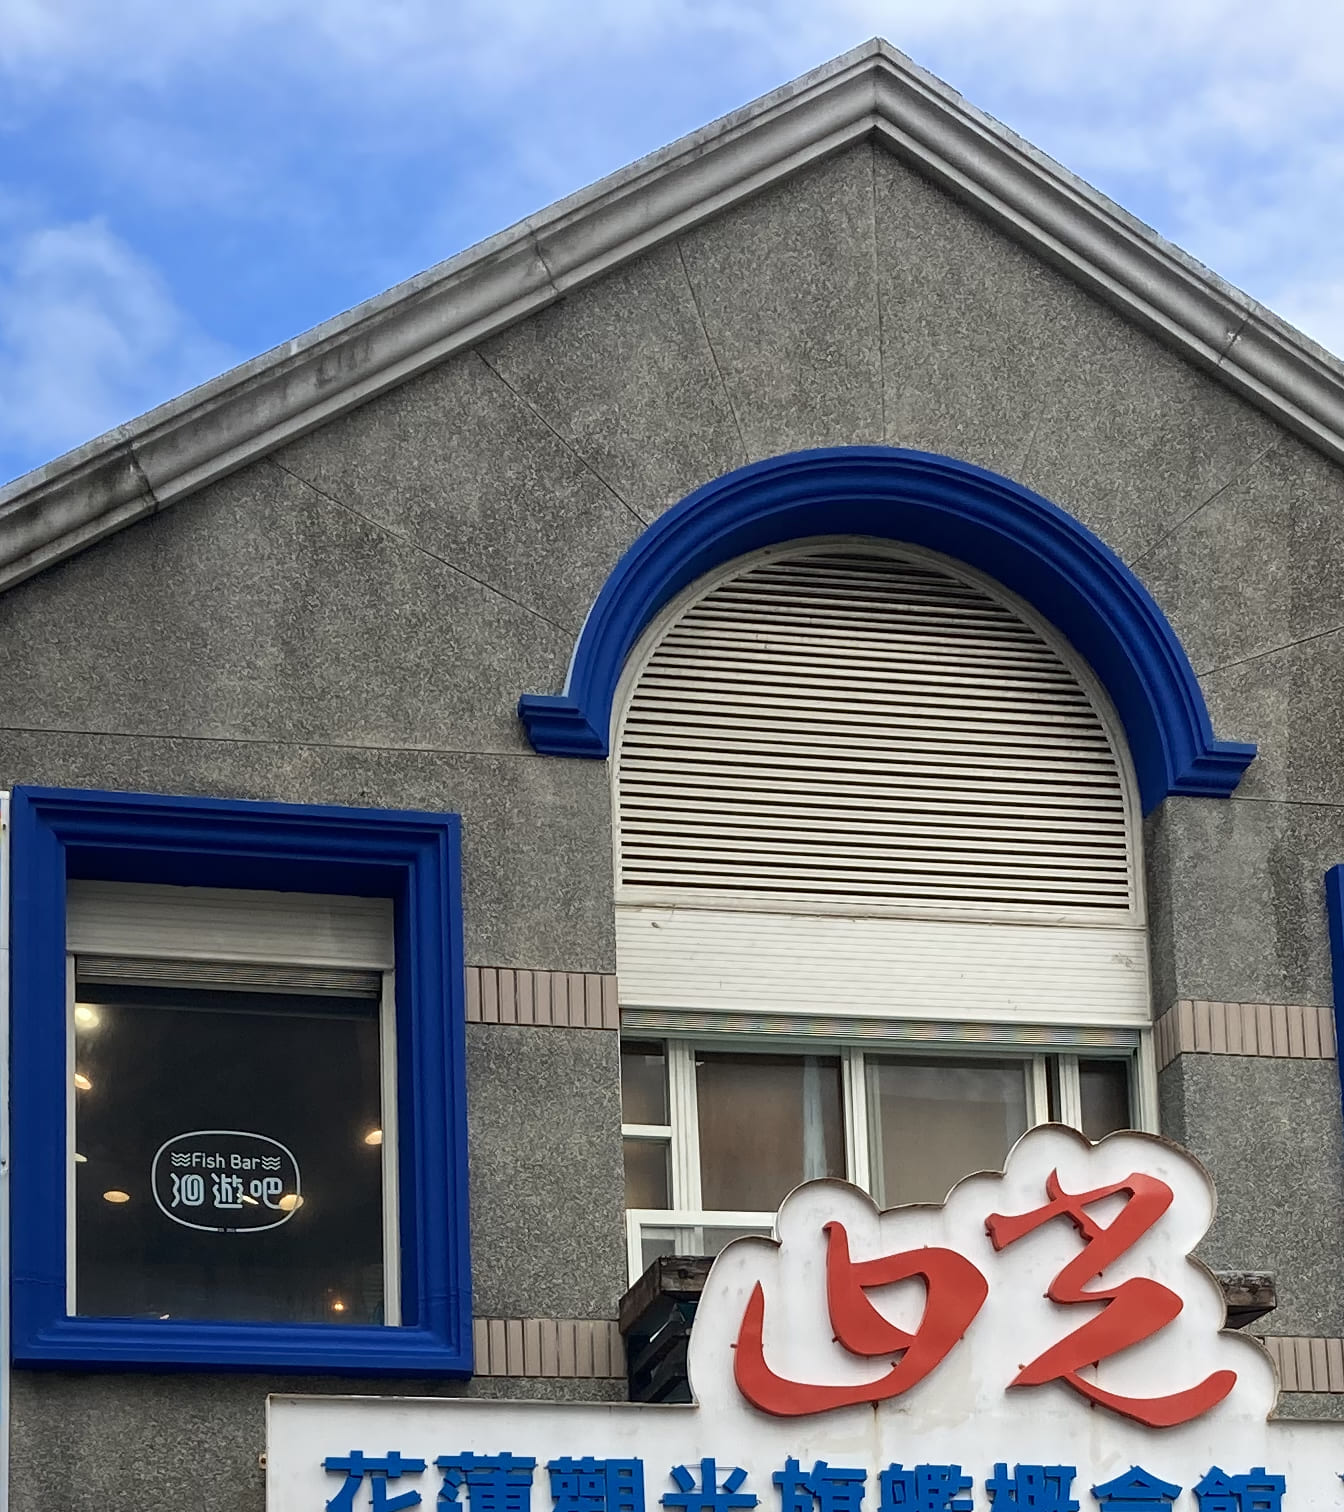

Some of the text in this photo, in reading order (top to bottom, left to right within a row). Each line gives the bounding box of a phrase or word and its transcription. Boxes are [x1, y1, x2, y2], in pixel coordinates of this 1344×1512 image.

[192, 1152, 262, 1170] Fish Bar
[170, 1172, 284, 1210] 洄遊吧
